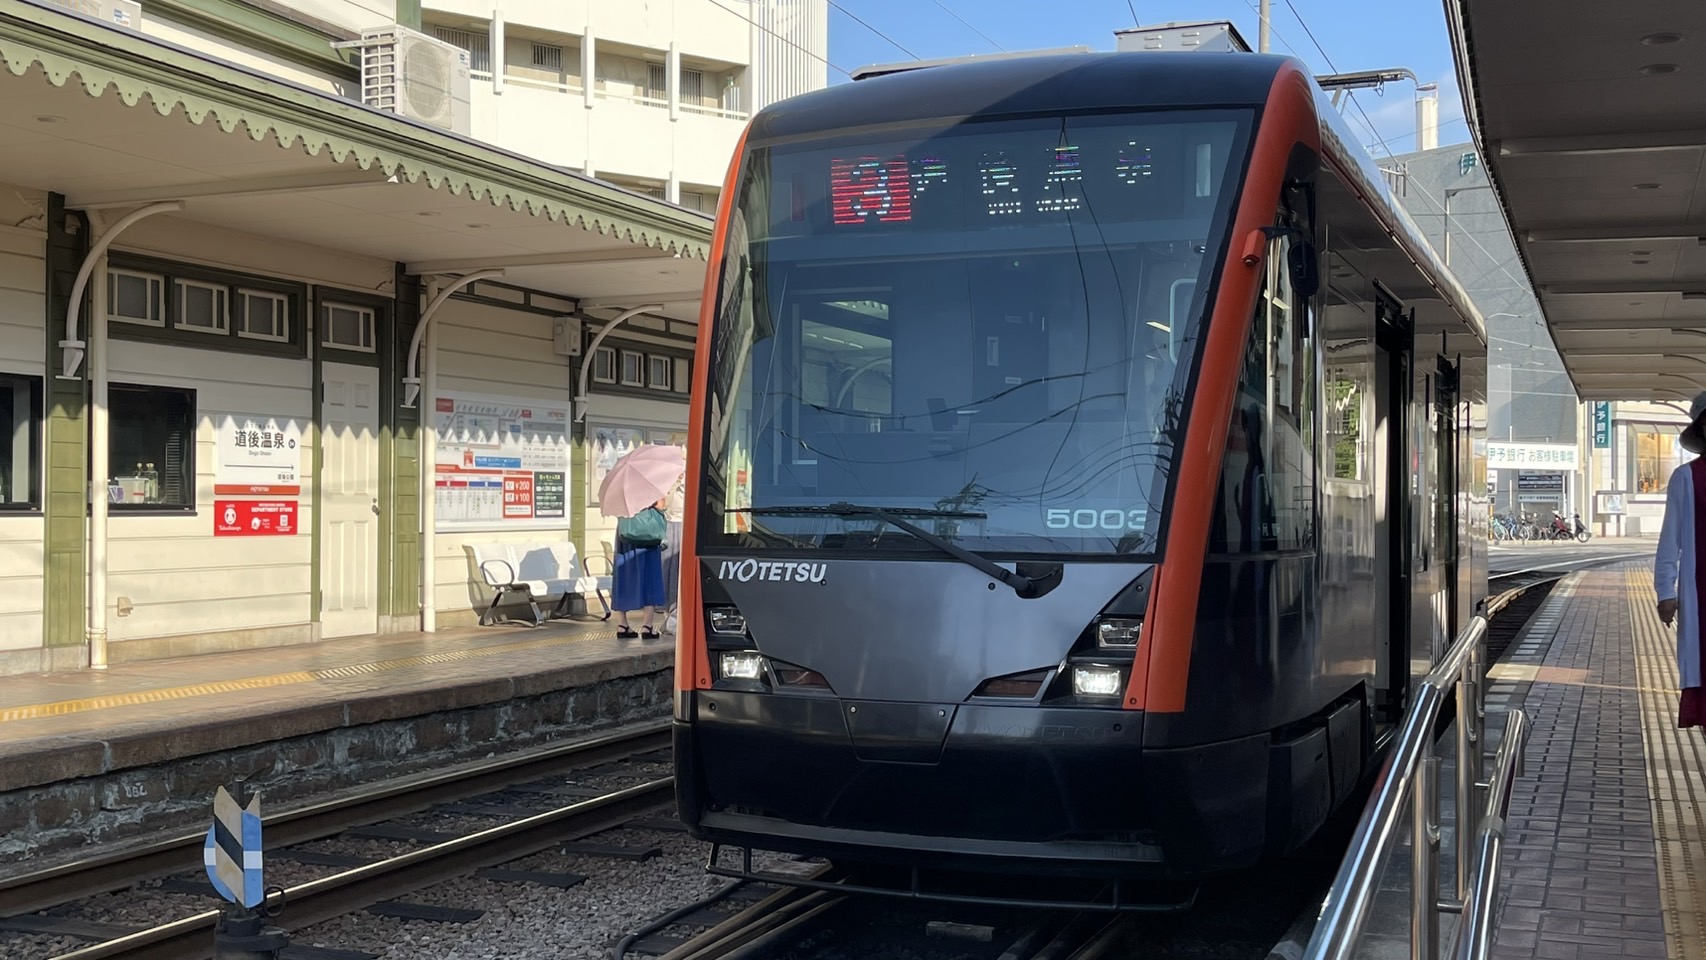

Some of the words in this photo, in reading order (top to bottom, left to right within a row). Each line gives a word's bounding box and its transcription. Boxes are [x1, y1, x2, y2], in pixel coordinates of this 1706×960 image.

[1596, 400, 1606, 444] 伊予銀行
[235, 430, 285, 449] 道後温泉
[515, 480, 530, 490] ¥200
[515, 492, 530, 503] ¥100
[1046, 508, 1147, 530] 5003
[718, 559, 827, 583] IYOTETSU
